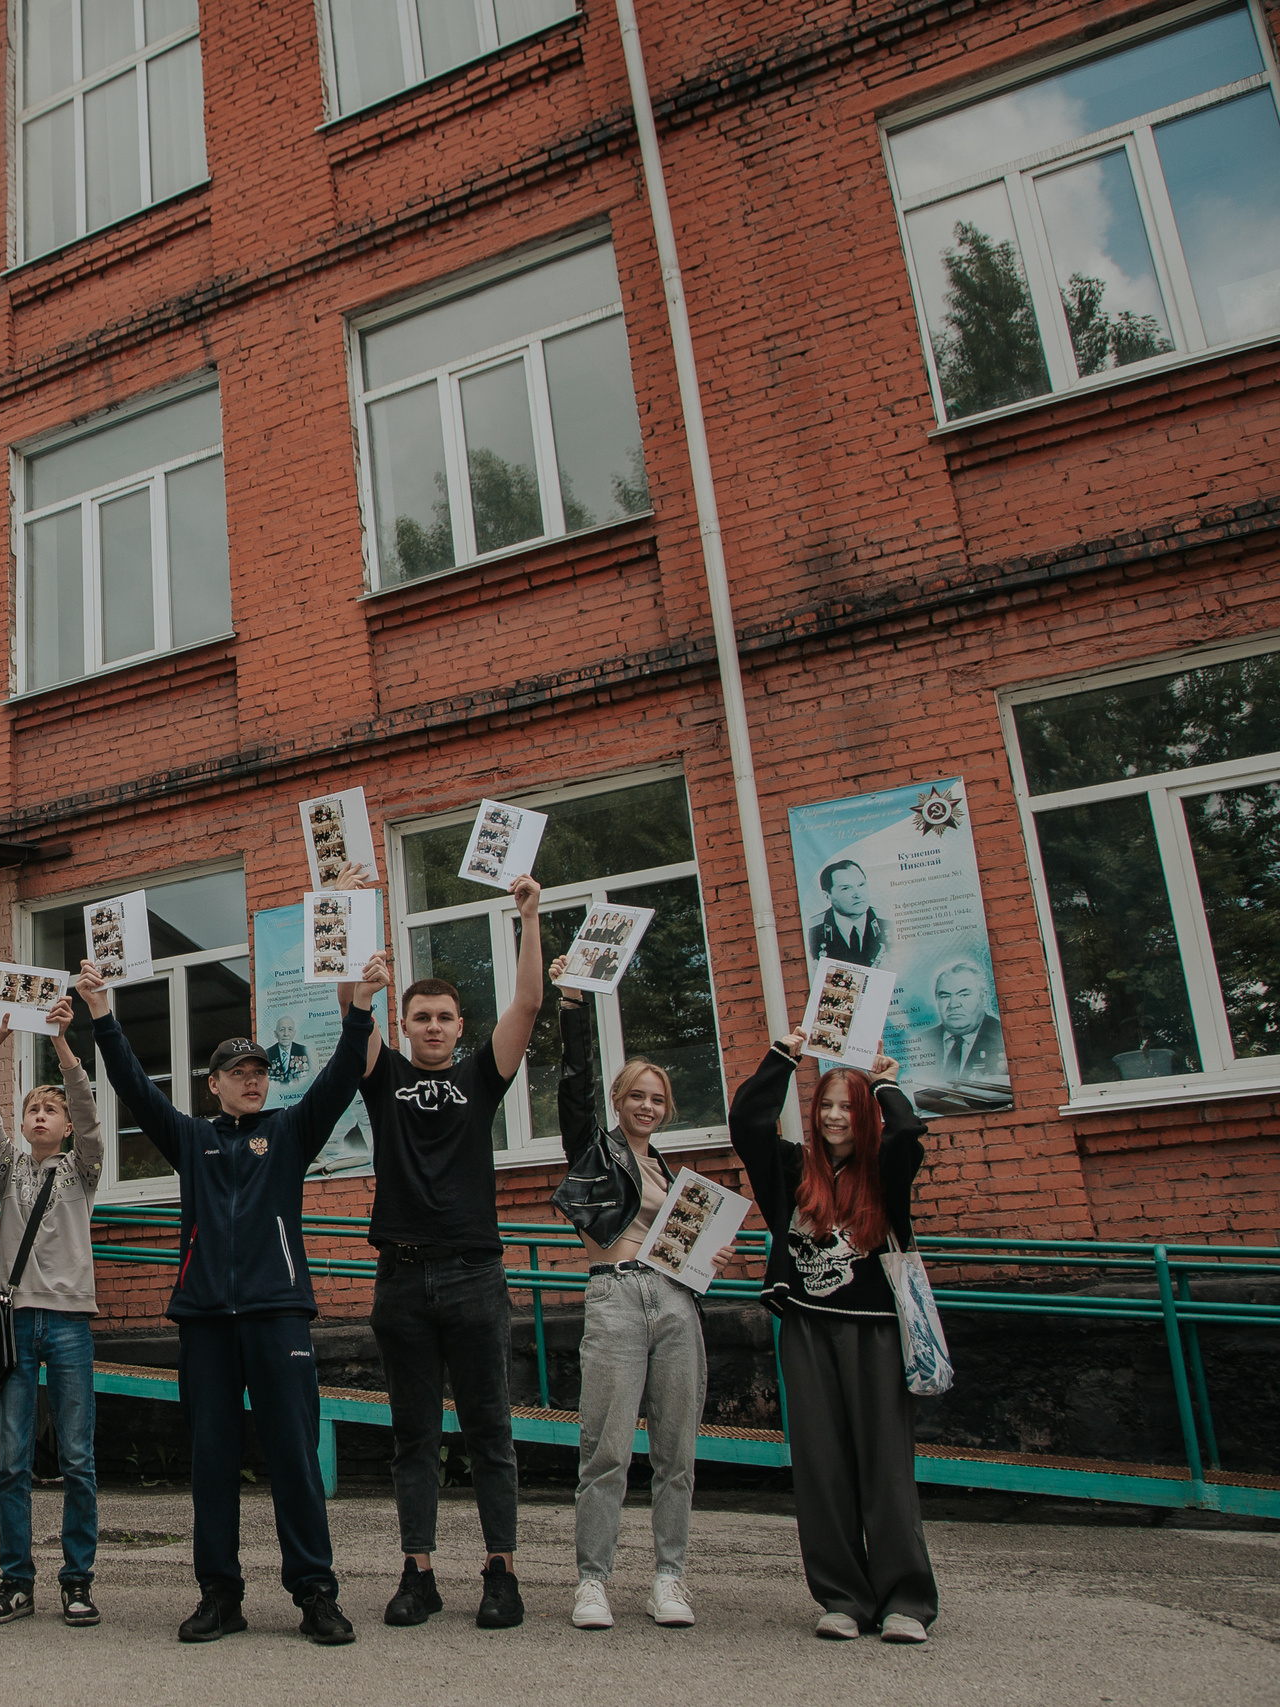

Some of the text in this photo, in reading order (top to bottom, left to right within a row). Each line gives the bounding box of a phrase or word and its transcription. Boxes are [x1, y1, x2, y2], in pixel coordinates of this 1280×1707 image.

[897, 848, 941, 862] Кузнецов
[899, 857, 942, 871] Николай
[889, 876, 927, 888] Выпускник
[927, 873, 950, 882] школы
[901, 897, 948, 909] форсирование
[894, 906, 931, 918] подавление
[895, 915, 933, 925] противника
[896, 919, 954, 933] присвоено звание
[897, 923, 977, 941] Героя Советского Союза
[883, 1020, 931, 1032] етербургского
